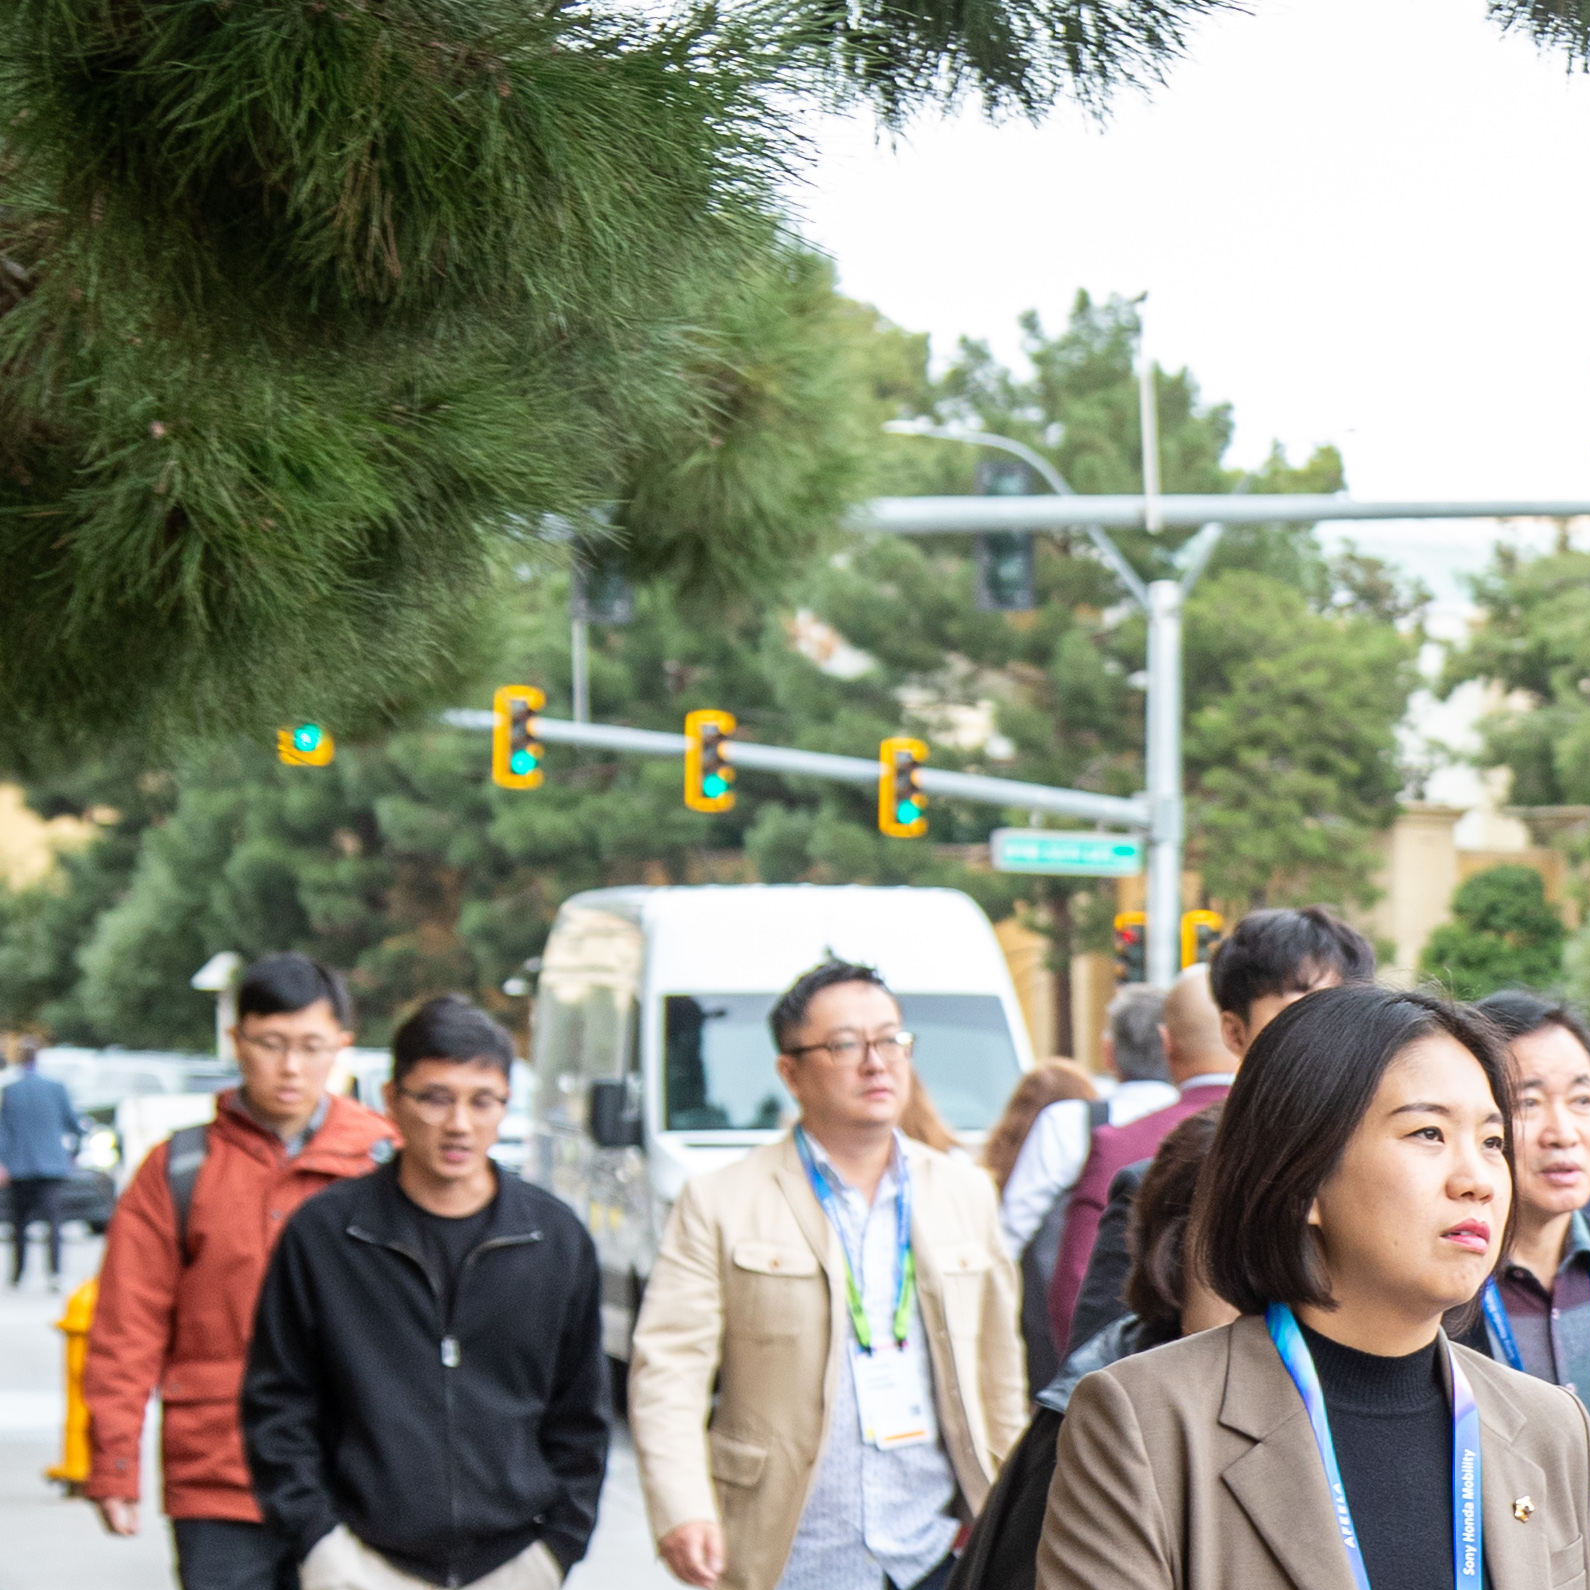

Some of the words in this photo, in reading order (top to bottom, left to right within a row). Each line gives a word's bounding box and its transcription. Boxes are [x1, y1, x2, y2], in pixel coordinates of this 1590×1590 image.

[1461, 1449, 1476, 1500] Mobility
[1462, 1502, 1475, 1542] Honda
[1463, 1544, 1477, 1576] Sony
